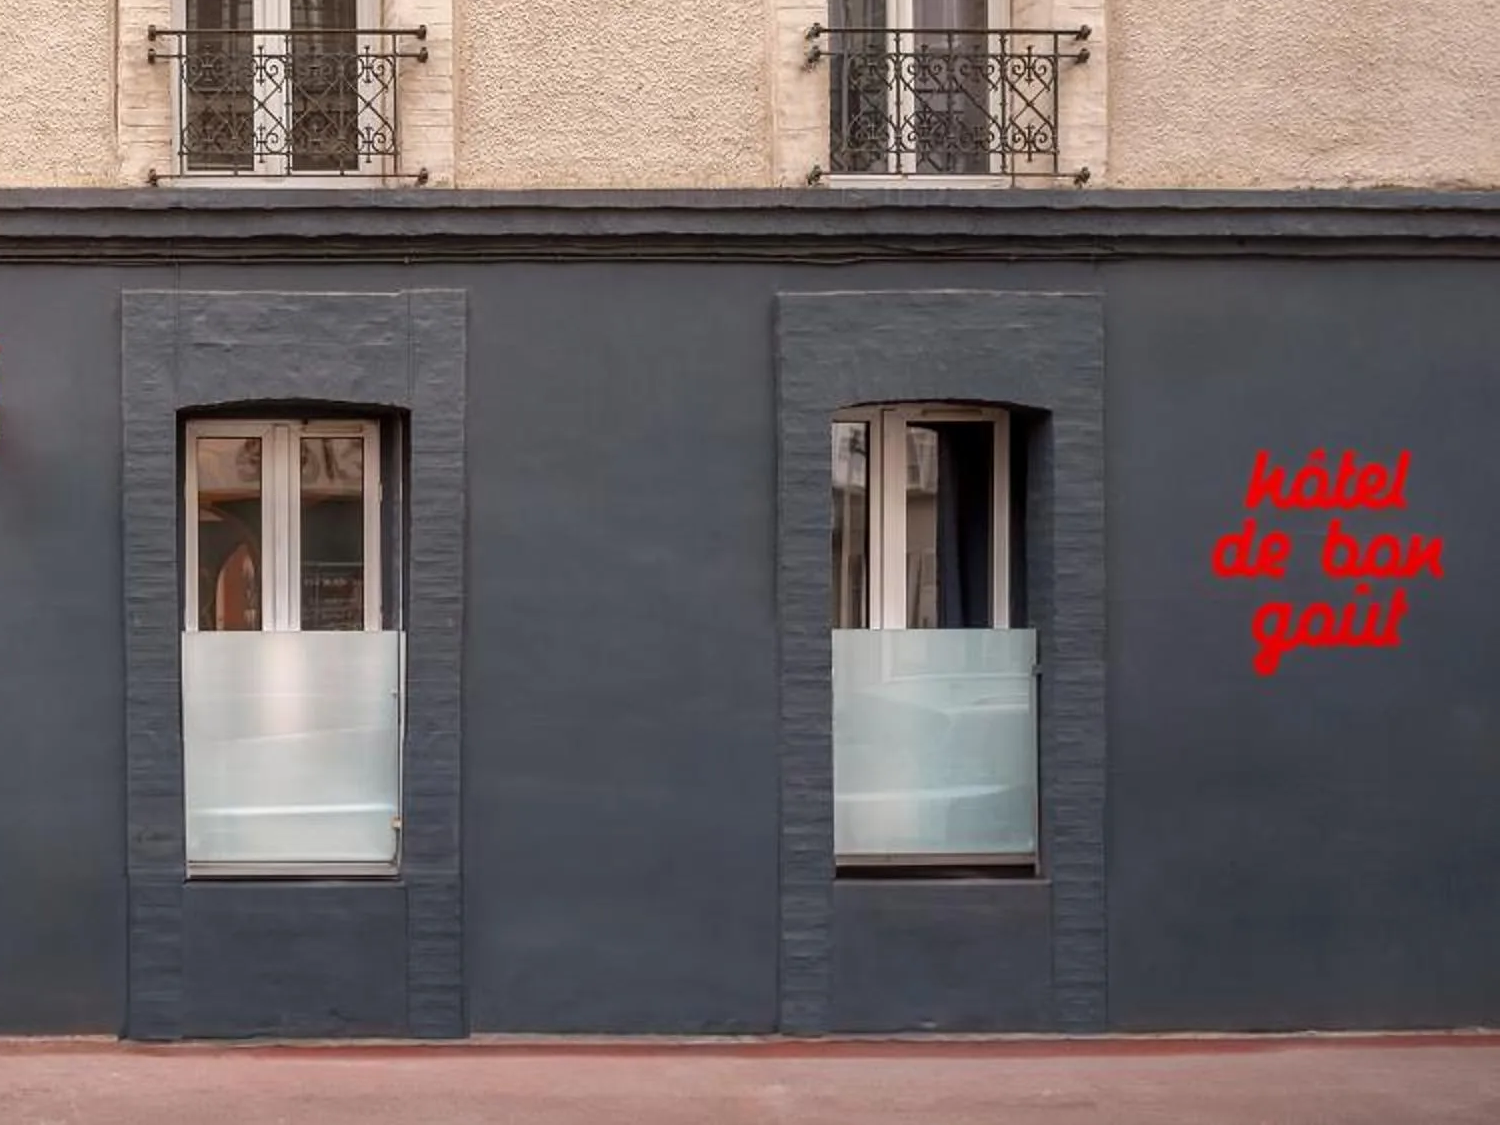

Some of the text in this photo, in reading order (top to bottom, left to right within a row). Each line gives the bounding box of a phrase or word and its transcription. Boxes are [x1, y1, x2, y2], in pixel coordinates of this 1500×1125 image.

[1244, 447, 1412, 510] hôtel
[1210, 517, 1445, 580] de bon
[1251, 581, 1409, 677] goût
